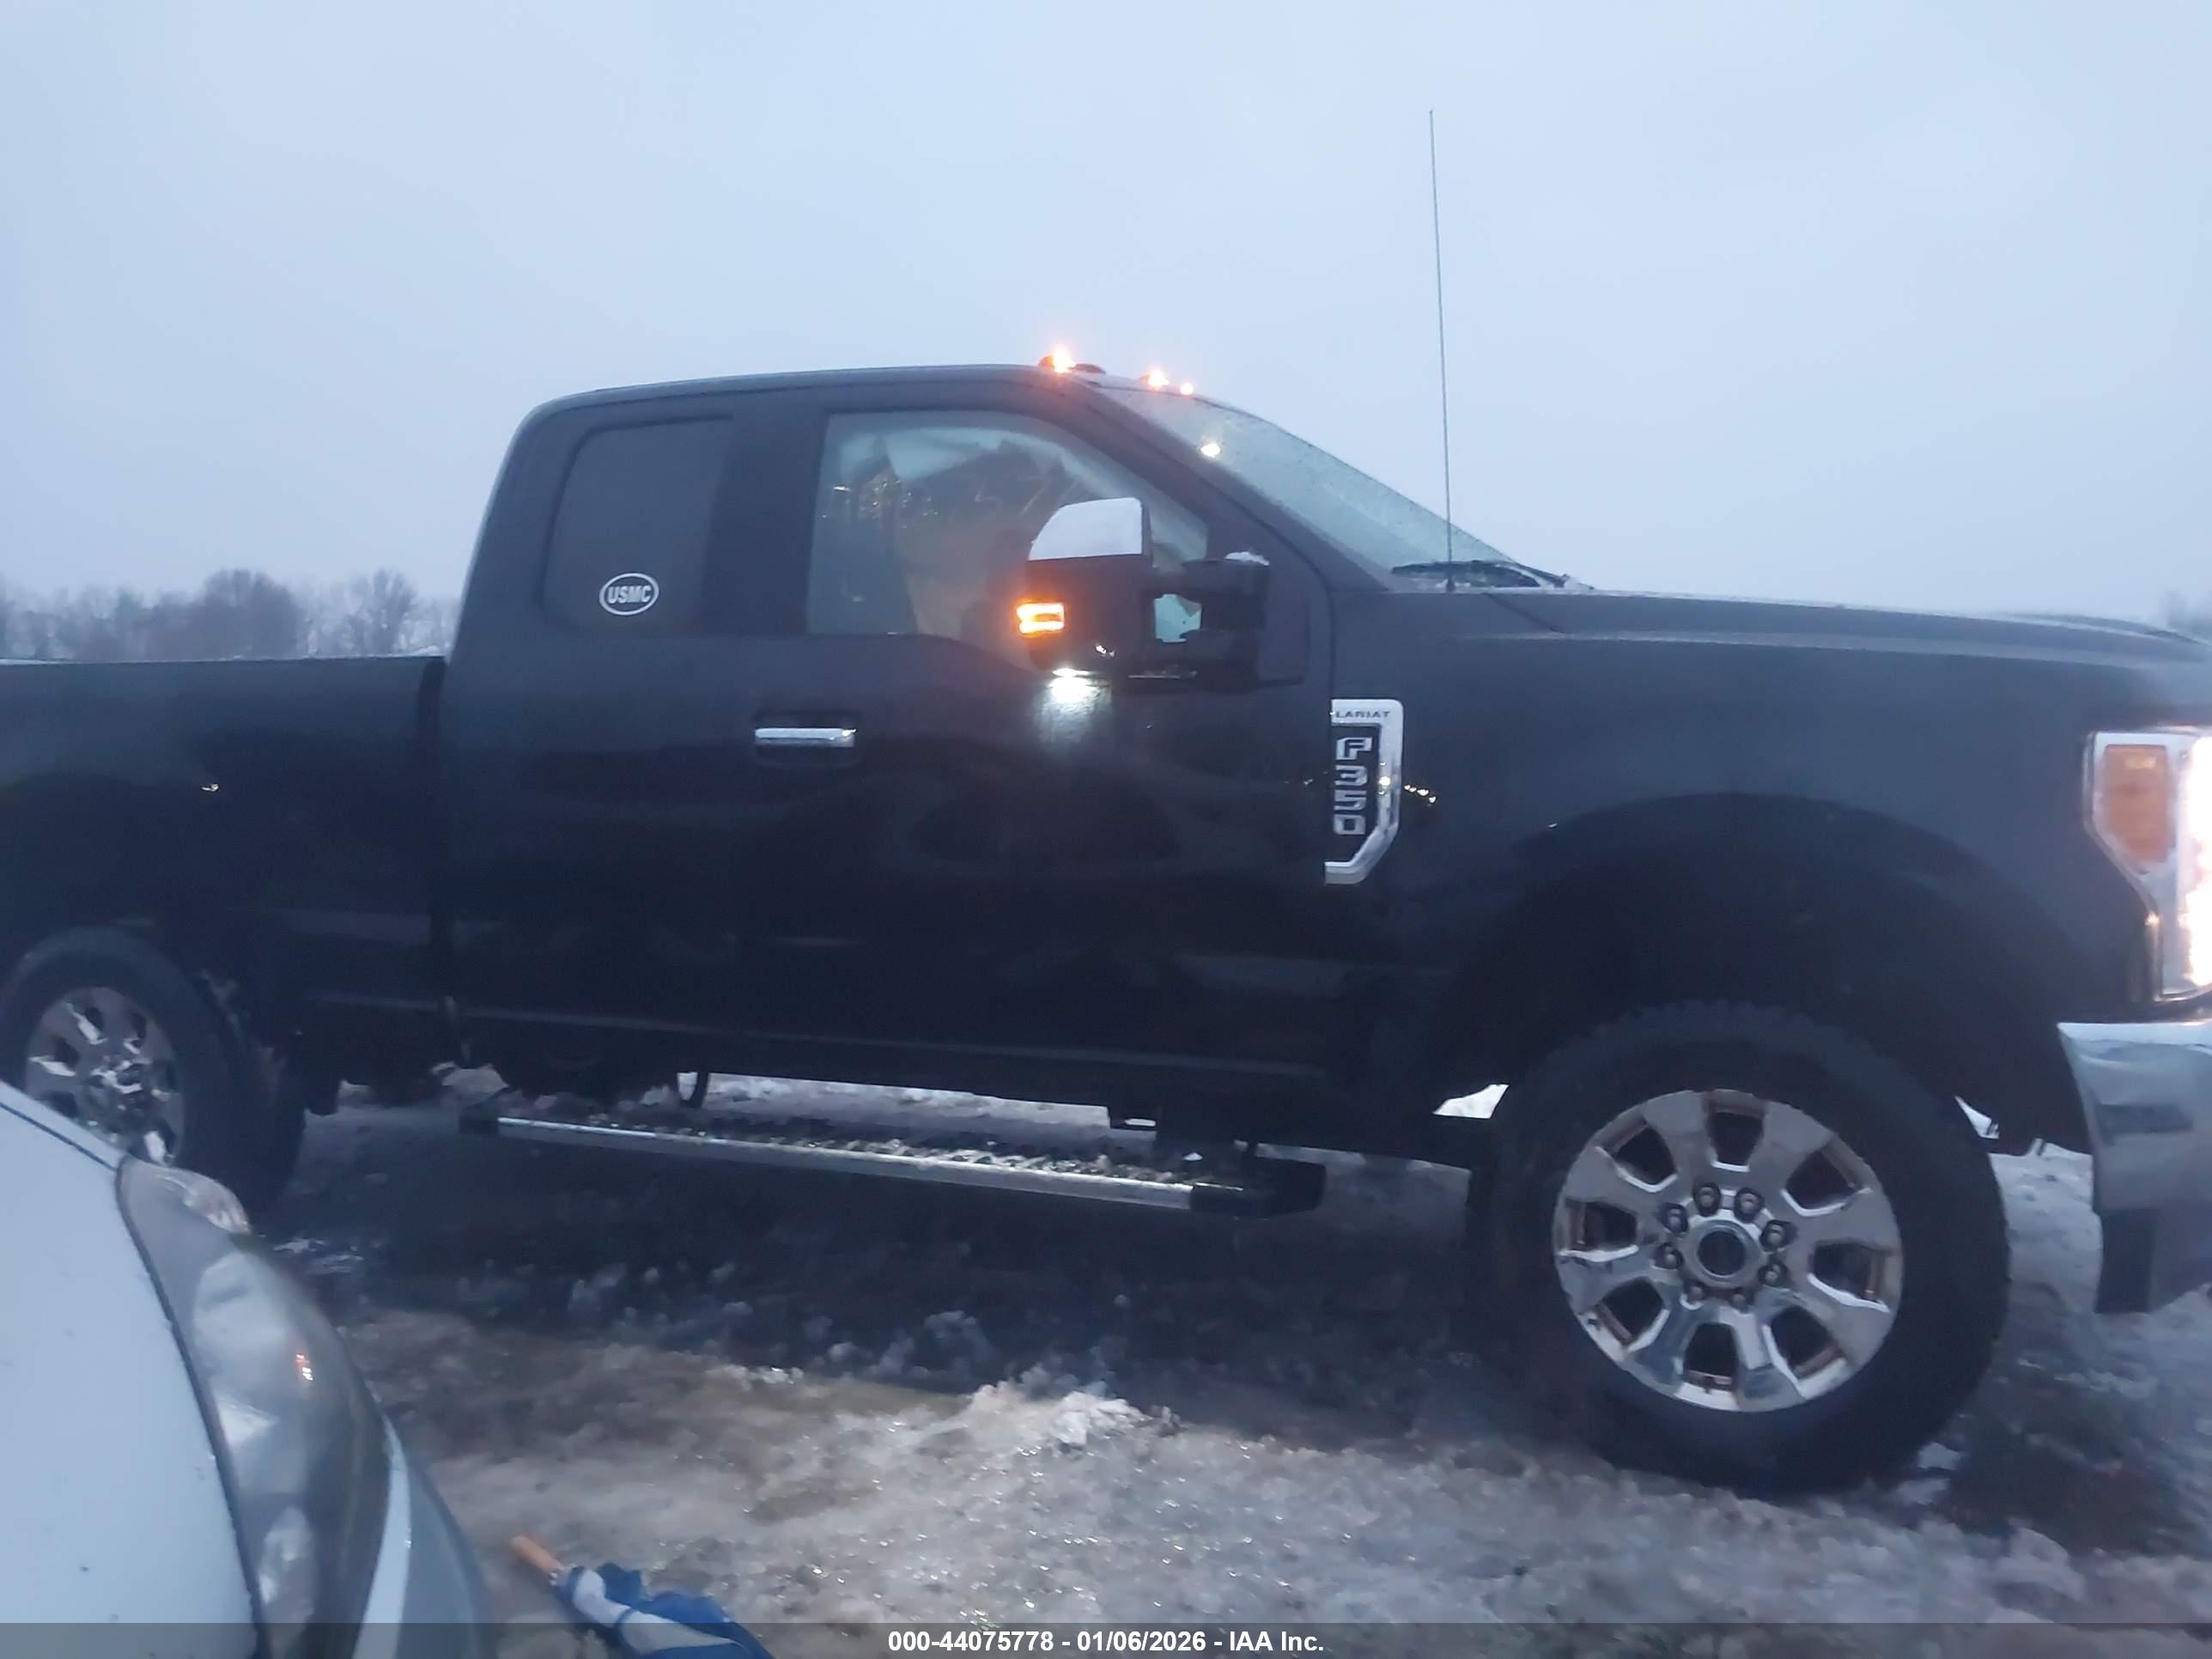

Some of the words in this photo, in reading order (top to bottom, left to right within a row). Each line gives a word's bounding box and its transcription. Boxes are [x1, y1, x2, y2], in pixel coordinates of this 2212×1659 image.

[607, 585, 652, 604] USMC
[1335, 710, 1390, 719] LARIAT
[1334, 737, 1372, 836] F350
